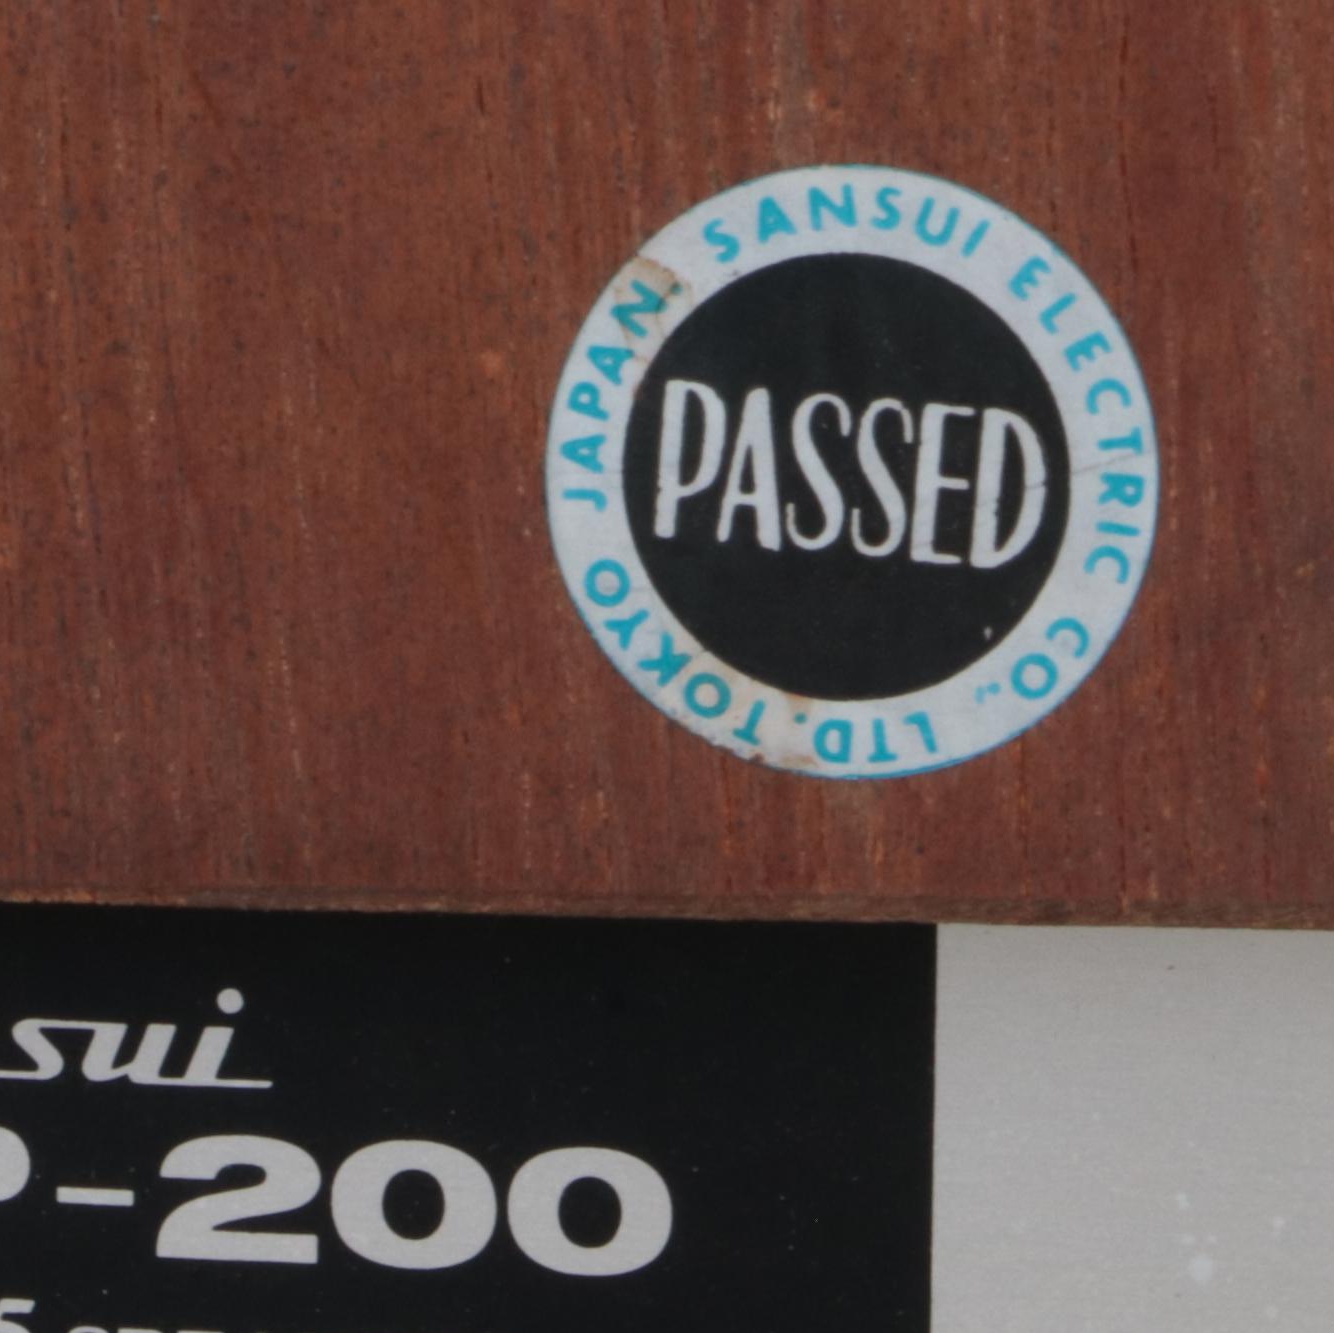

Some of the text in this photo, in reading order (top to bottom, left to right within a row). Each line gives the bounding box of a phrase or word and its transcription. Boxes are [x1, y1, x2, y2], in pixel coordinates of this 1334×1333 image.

[702, 184, 991, 264] SANSUI
[653, 376, 1049, 570] PASSED
[1008, 255, 1147, 584] ELECTRIC
[582, 558, 766, 745] TOKYO
[792, 711, 940, 766] LTD.
